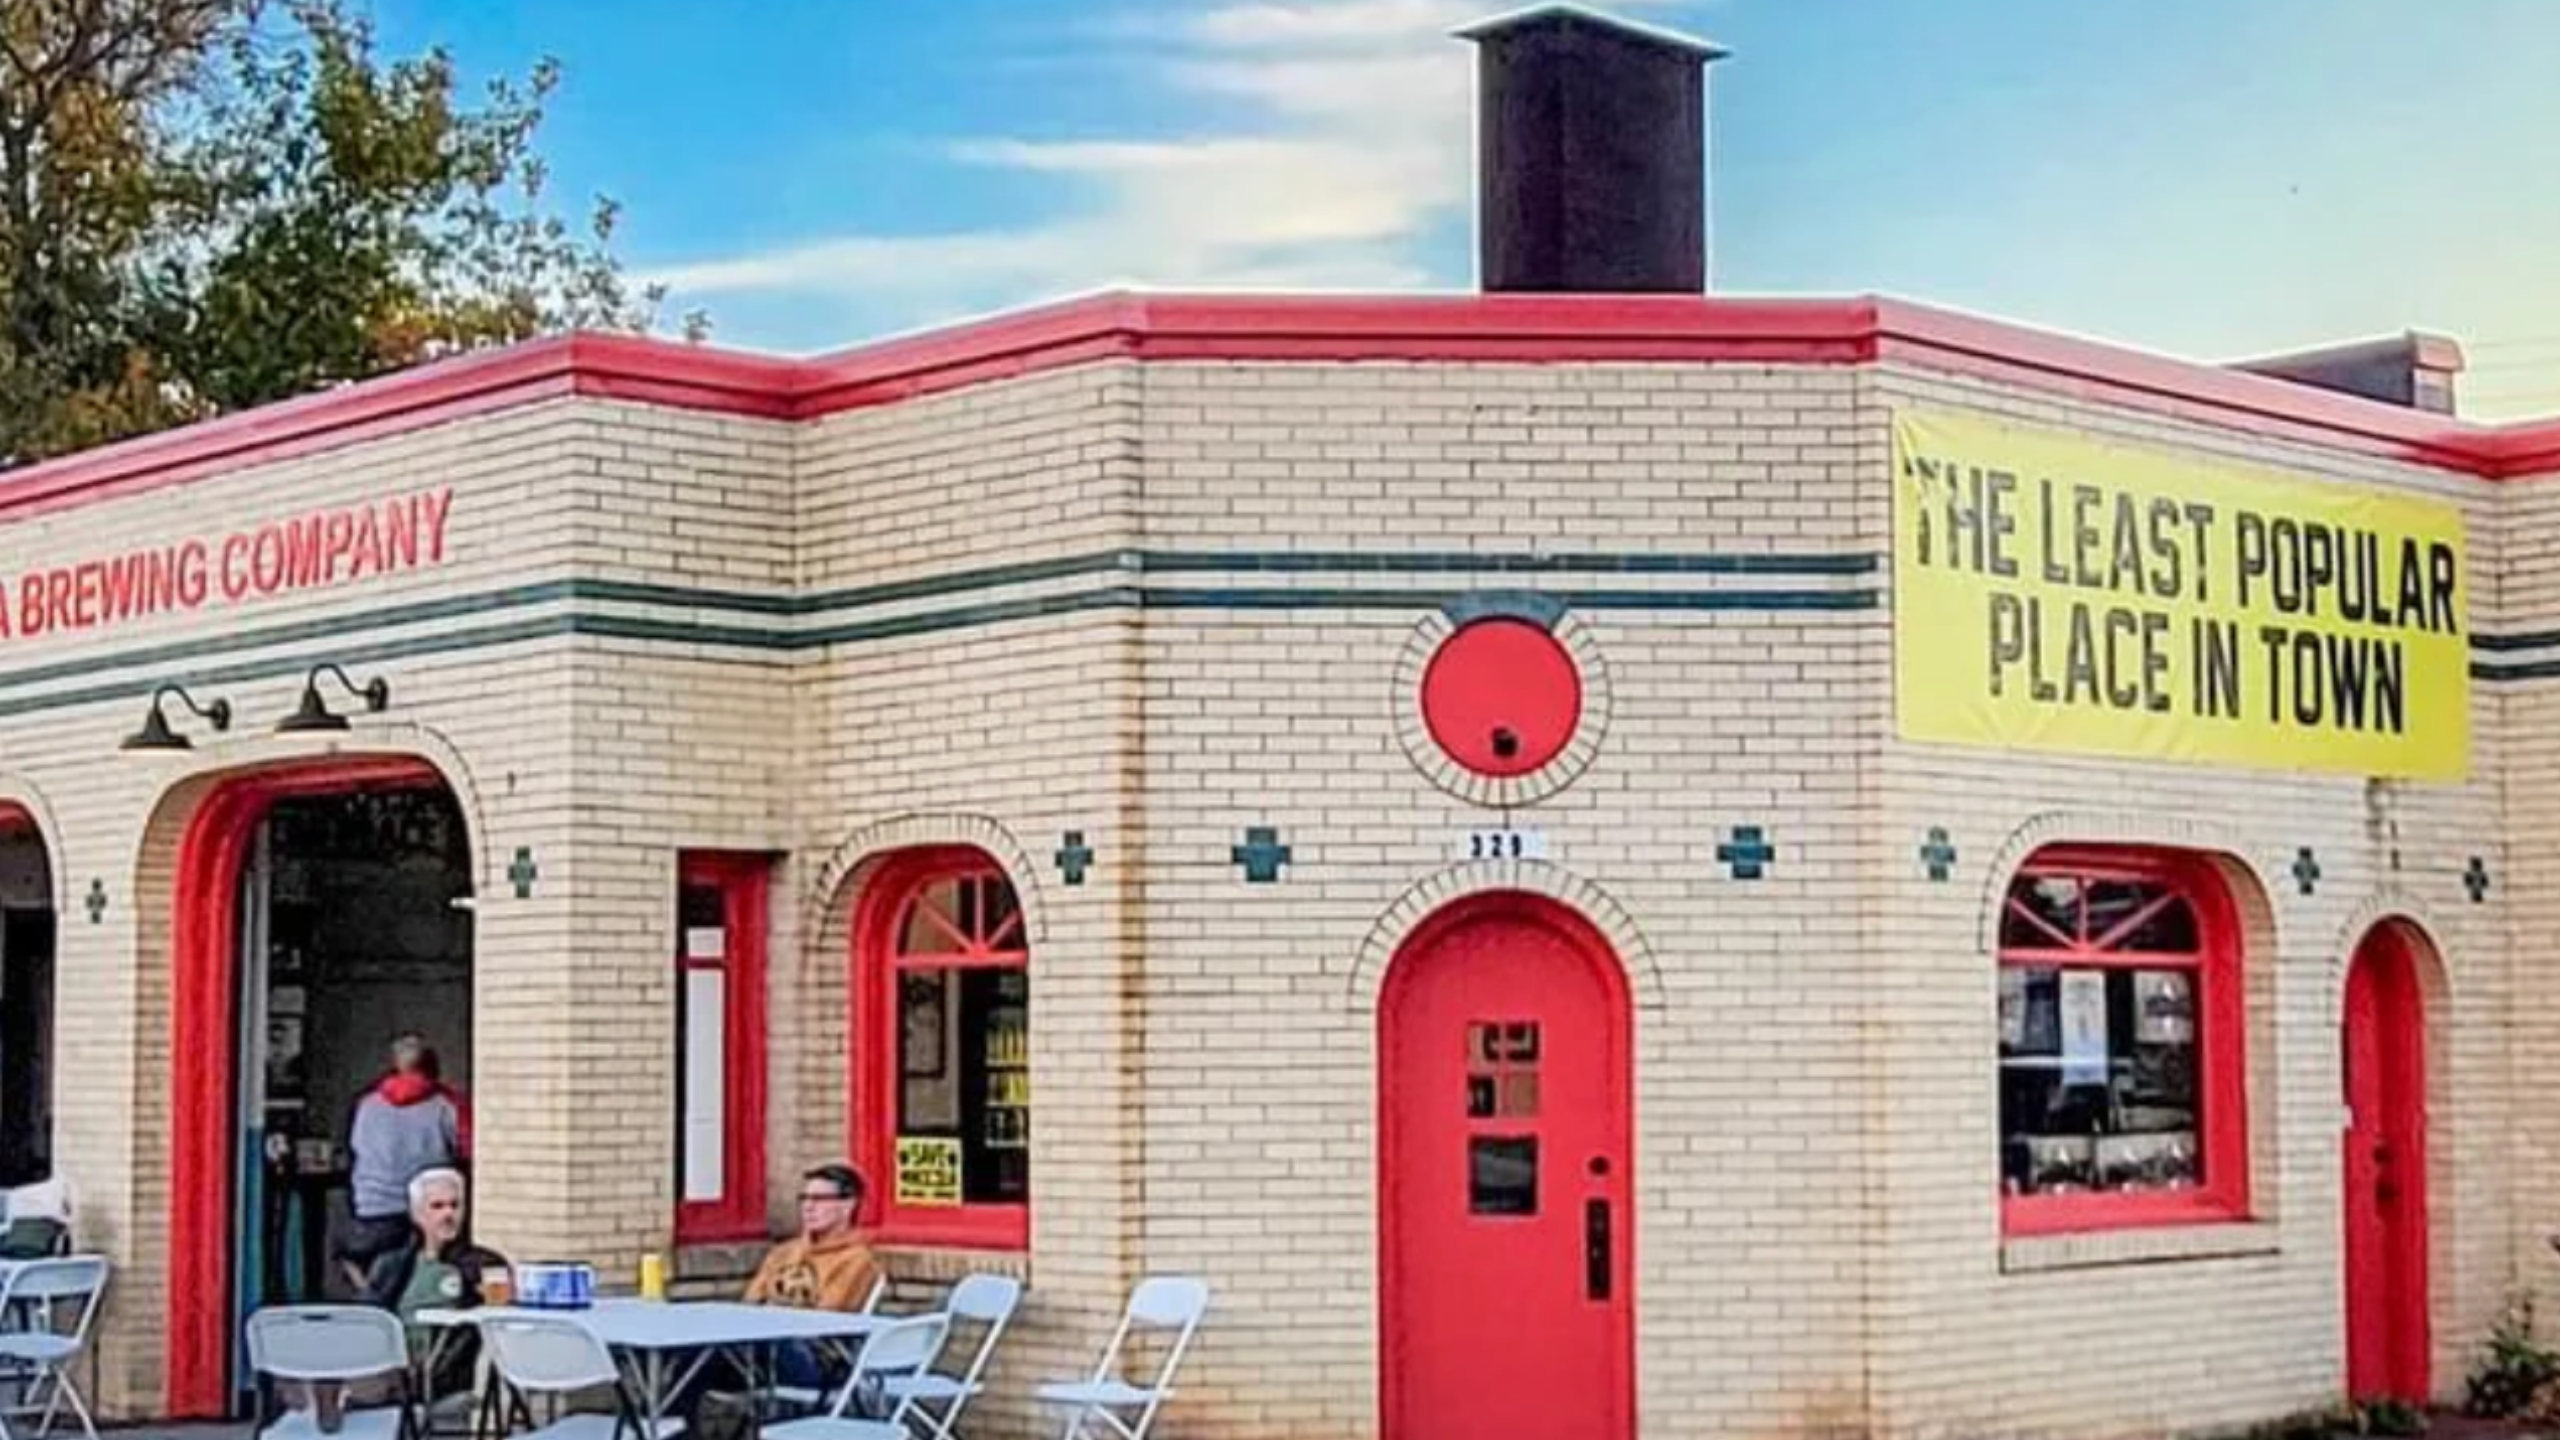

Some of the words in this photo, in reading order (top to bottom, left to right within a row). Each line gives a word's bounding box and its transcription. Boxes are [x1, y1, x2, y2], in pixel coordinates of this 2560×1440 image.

[19, 540, 207, 636] BREWING
[221, 487, 454, 600] COMPANY
[1903, 455, 2019, 577] THE
[2040, 480, 2213, 602] LEAST
[2235, 510, 2457, 634] POPULAR
[1988, 592, 2170, 712] PLACE
[2193, 617, 2239, 718] IN
[2261, 626, 2402, 734] TOWN
